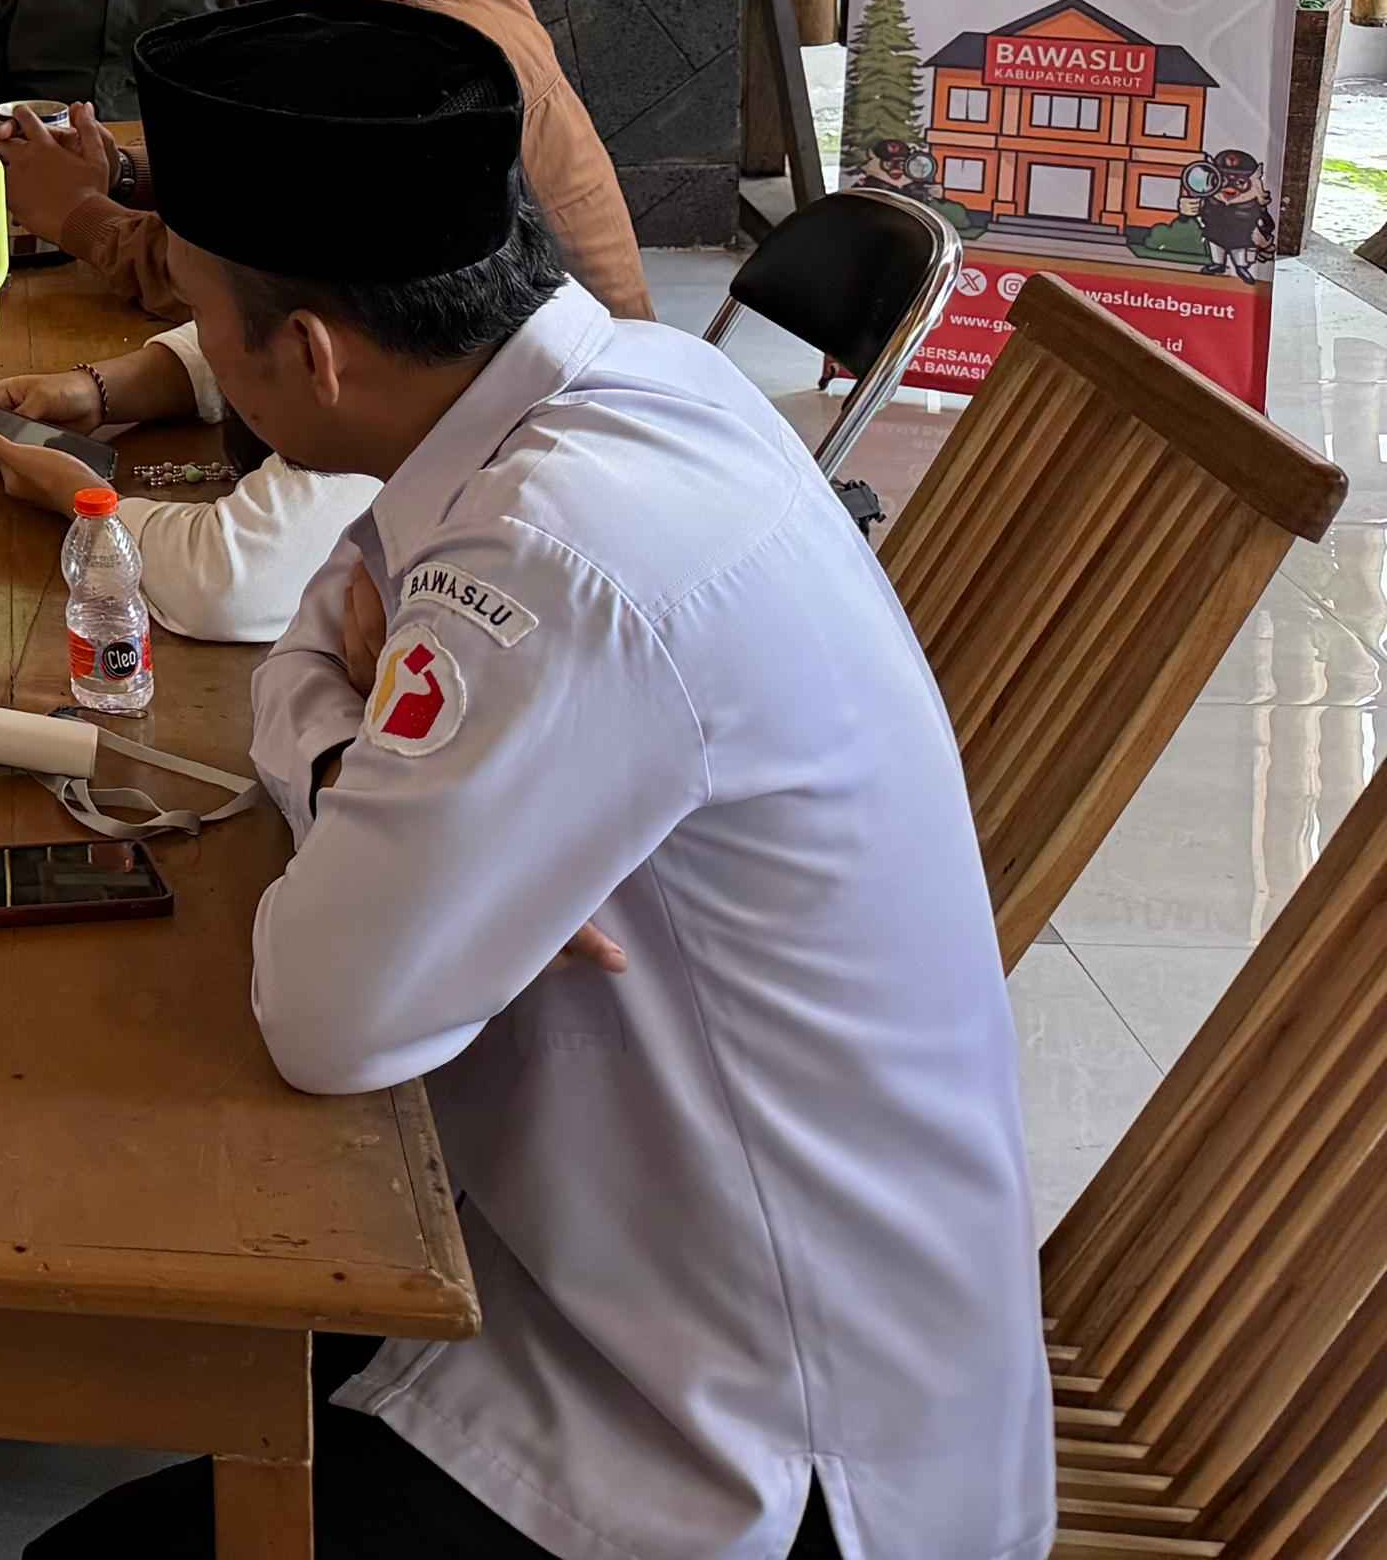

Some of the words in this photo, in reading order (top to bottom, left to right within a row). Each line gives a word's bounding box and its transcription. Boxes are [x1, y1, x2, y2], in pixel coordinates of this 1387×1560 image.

[996, 43, 1145, 73] BAWASLU
[994, 68, 1085, 85] KABUPATEN
[1090, 75, 1142, 89] GARUT
[408, 570, 513, 626] BAWASLU
[107, 650, 136, 670] Cleo
